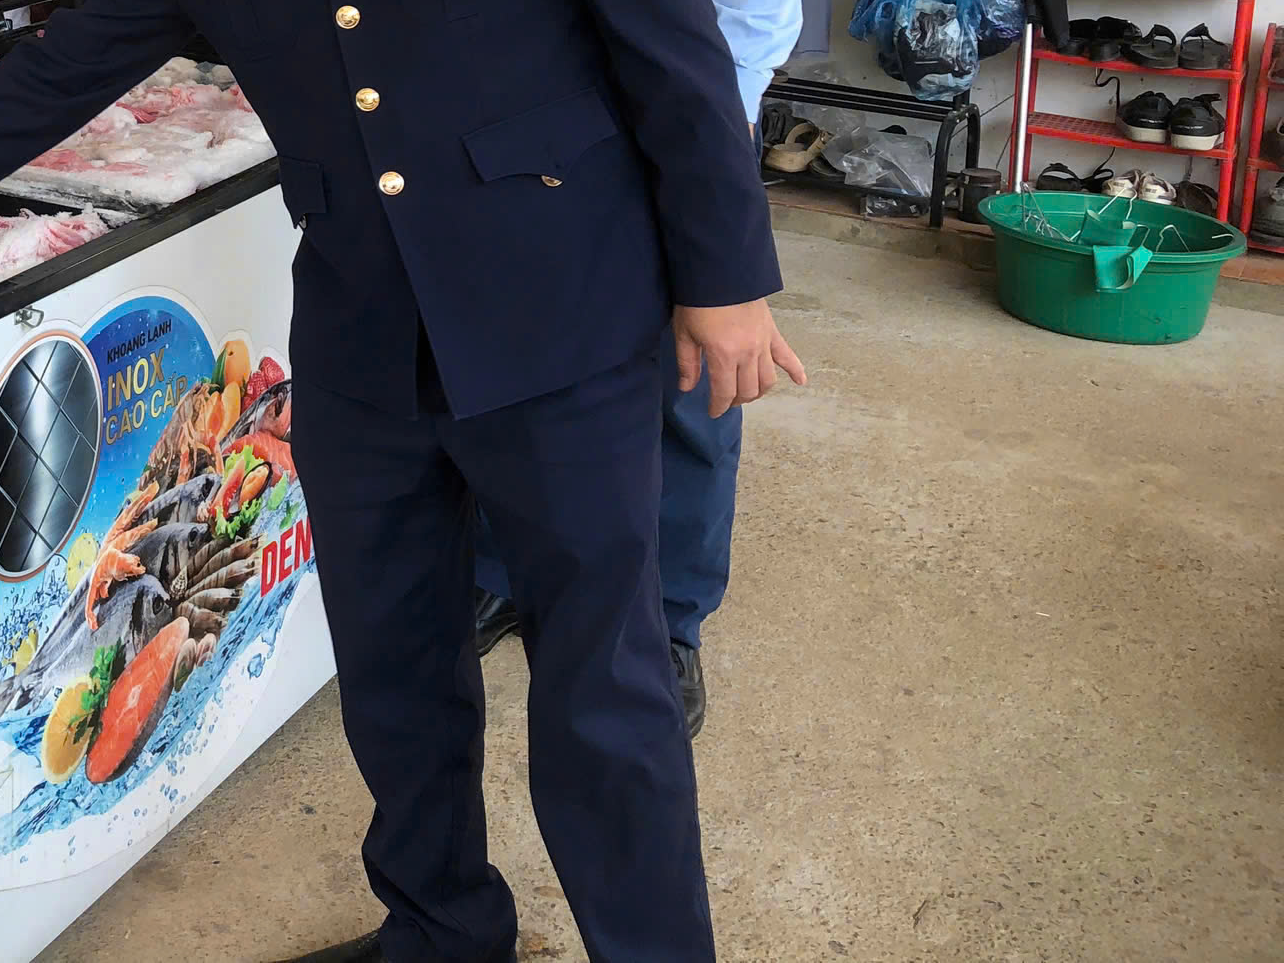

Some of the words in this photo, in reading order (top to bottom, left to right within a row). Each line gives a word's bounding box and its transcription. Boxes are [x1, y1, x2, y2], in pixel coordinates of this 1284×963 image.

[107, 333, 146, 365] KHOANG
[107, 348, 165, 412] INOX
[106, 400, 146, 445] CAO
[150, 371, 188, 418] CẤP
[260, 517, 313, 597] DEN
